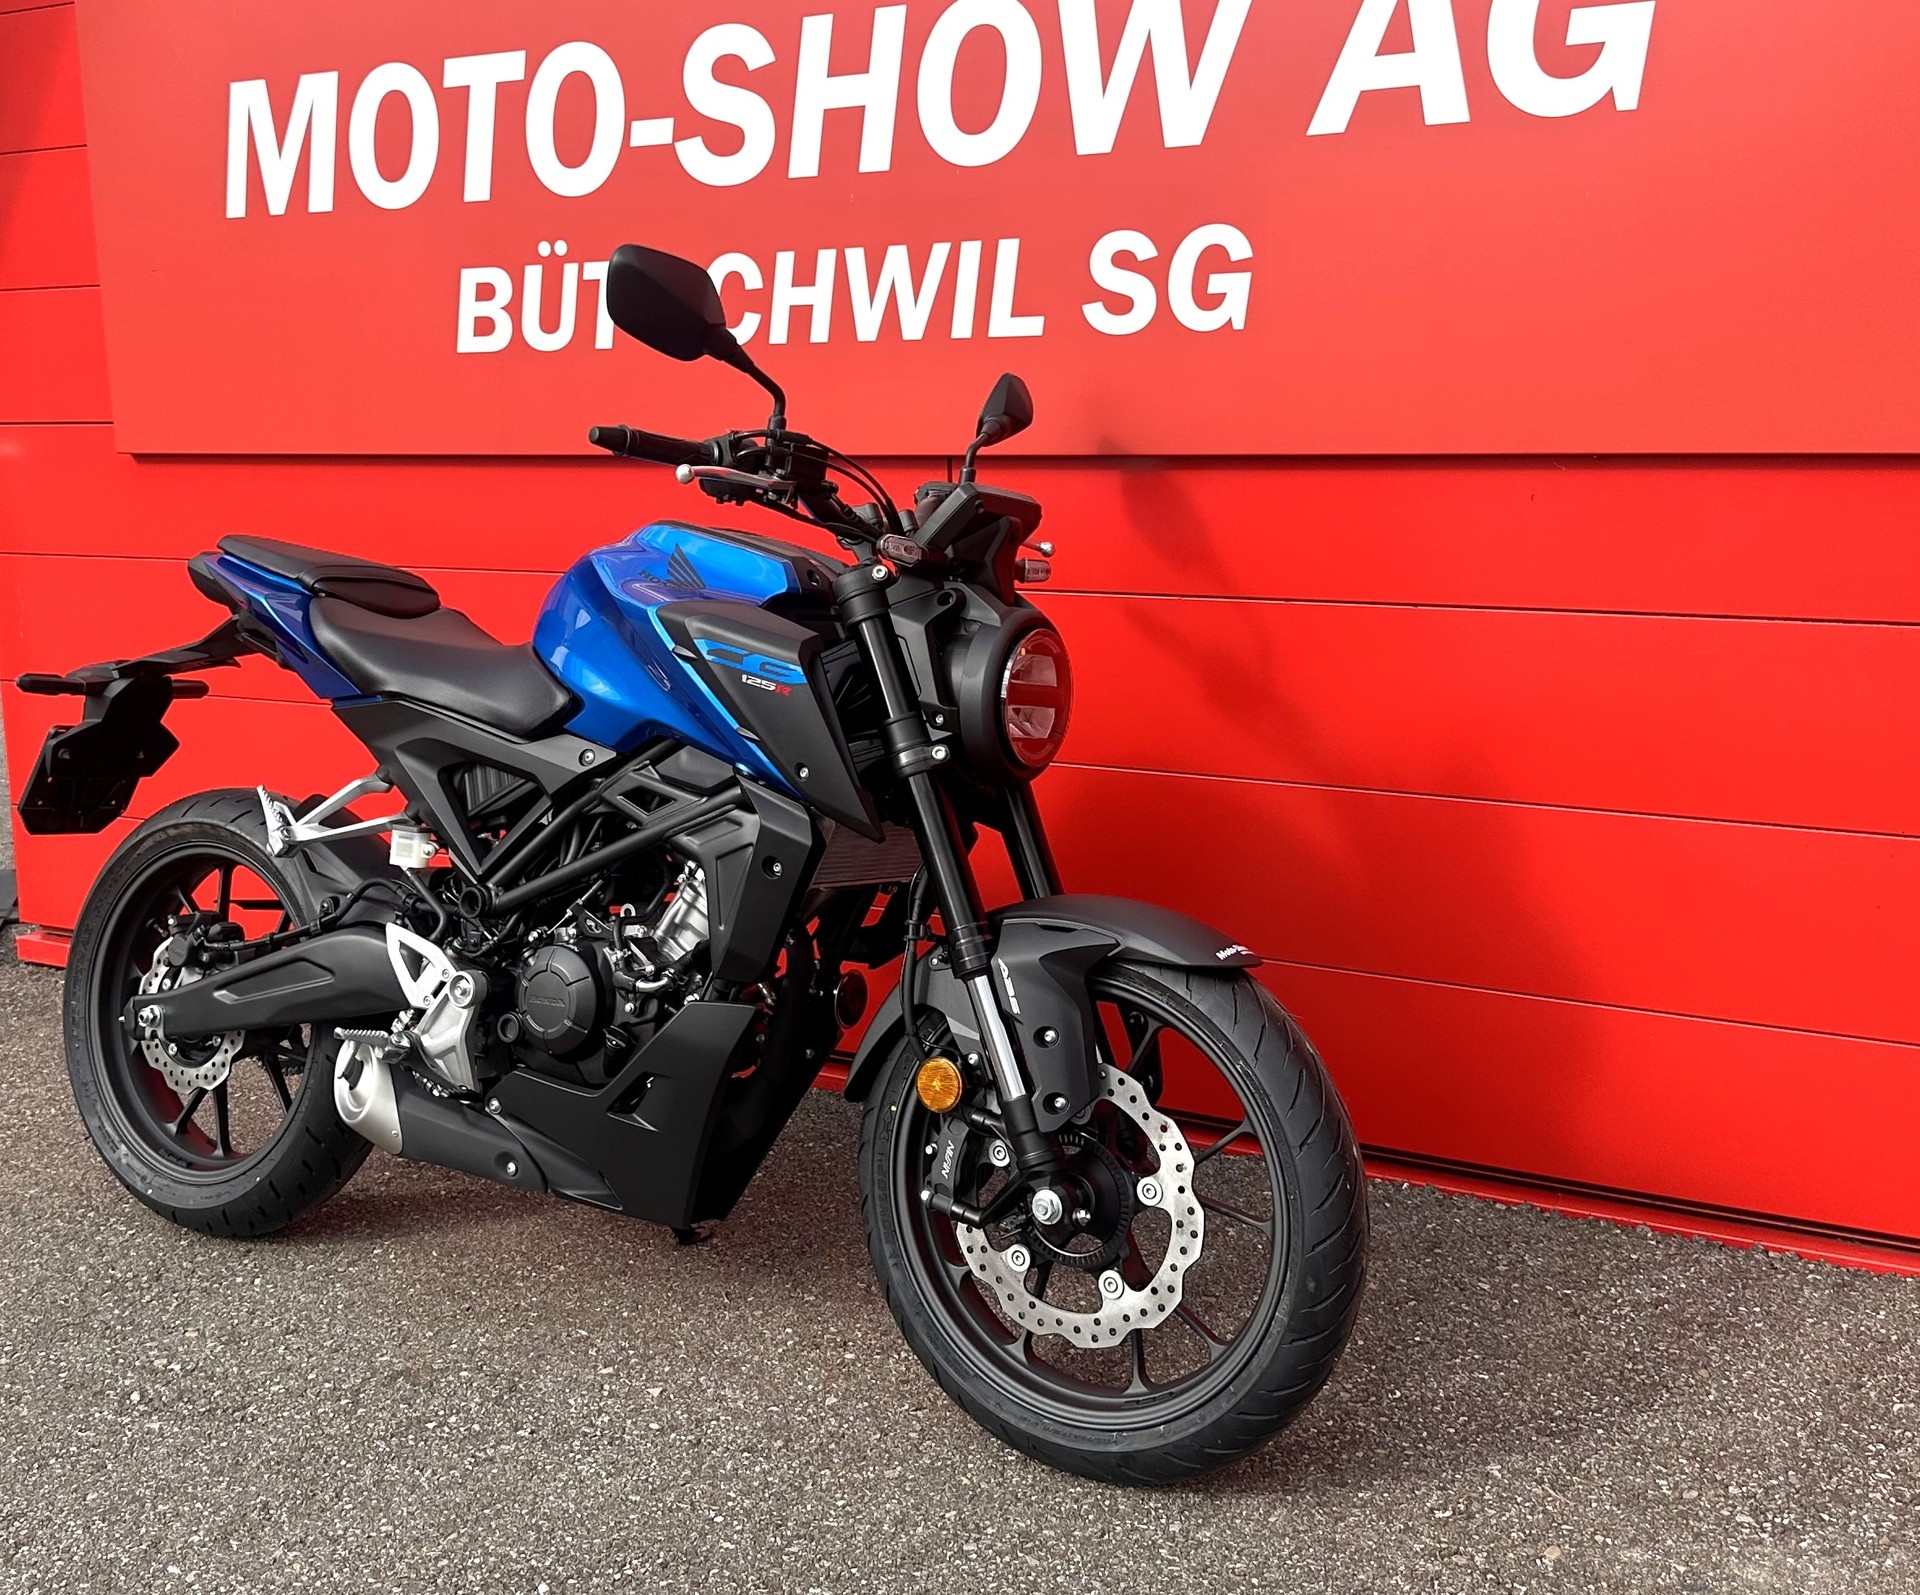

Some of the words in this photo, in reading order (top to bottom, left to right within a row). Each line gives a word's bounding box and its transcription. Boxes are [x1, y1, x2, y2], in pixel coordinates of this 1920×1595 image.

[226, 0, 1253, 218] MOTO-SHOW
[1306, 0, 1656, 136] AG
[456, 238, 1045, 353] BÜTCHWIL
[1081, 223, 1254, 335] SG
[741, 673, 793, 697] 125R
[997, 957, 1021, 1015] ABS
